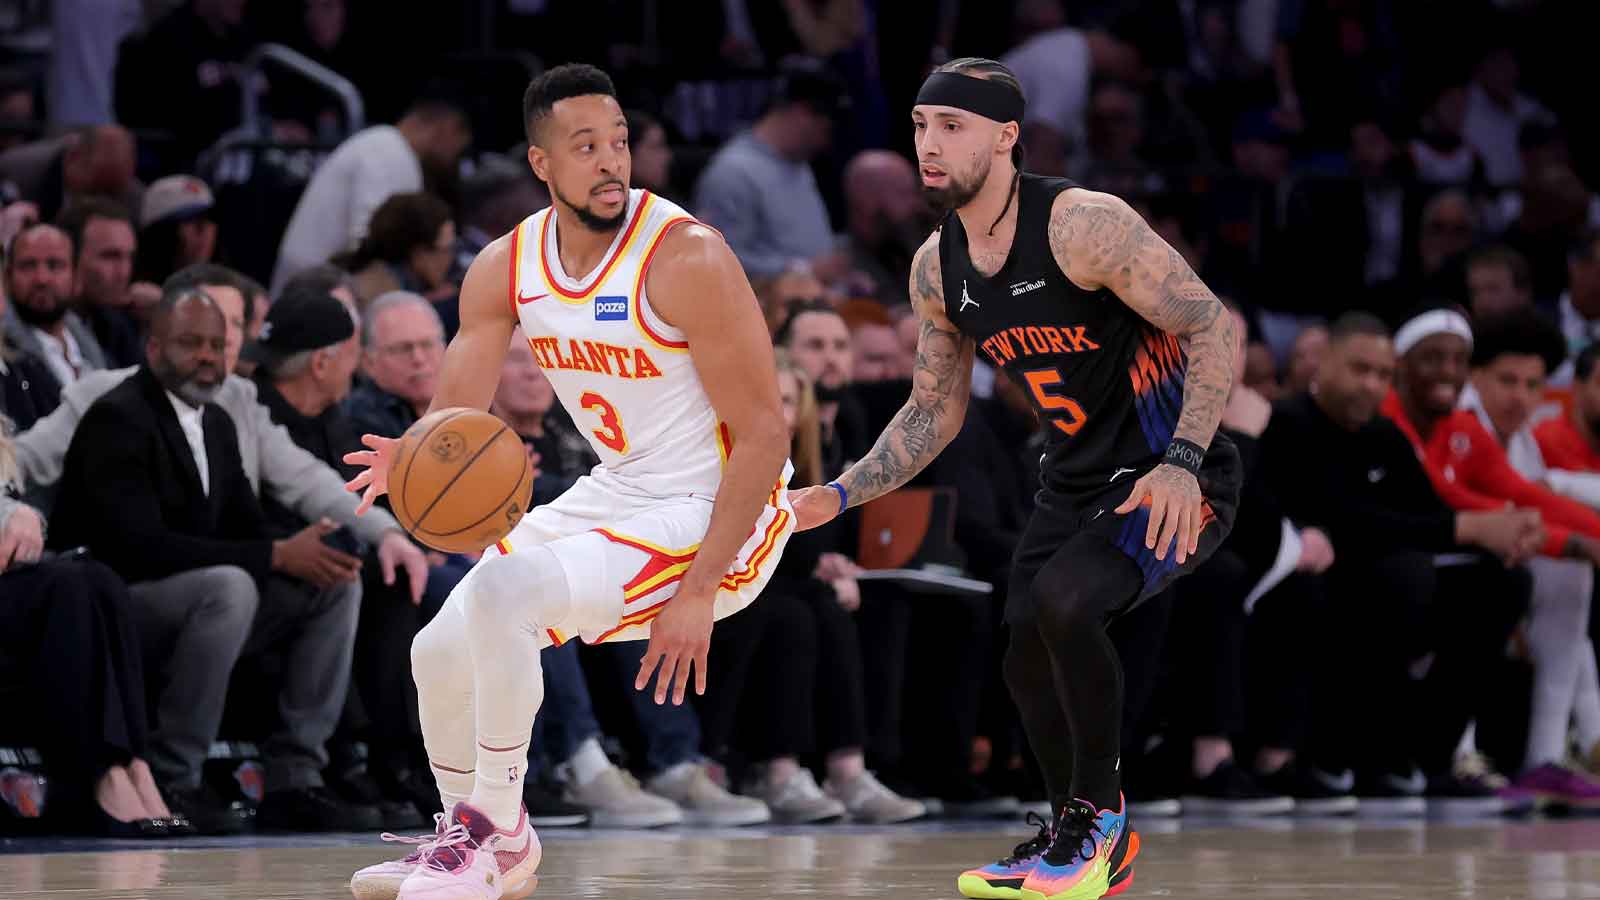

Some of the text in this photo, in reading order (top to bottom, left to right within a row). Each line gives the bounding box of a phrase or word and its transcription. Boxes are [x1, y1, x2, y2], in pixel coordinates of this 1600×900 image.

[596, 302, 626, 316] paze
[1012, 287, 1026, 296] abu
[981, 326, 1101, 367] EW YORK
[580, 391, 629, 455] 3
[1023, 368, 1088, 437] 5
